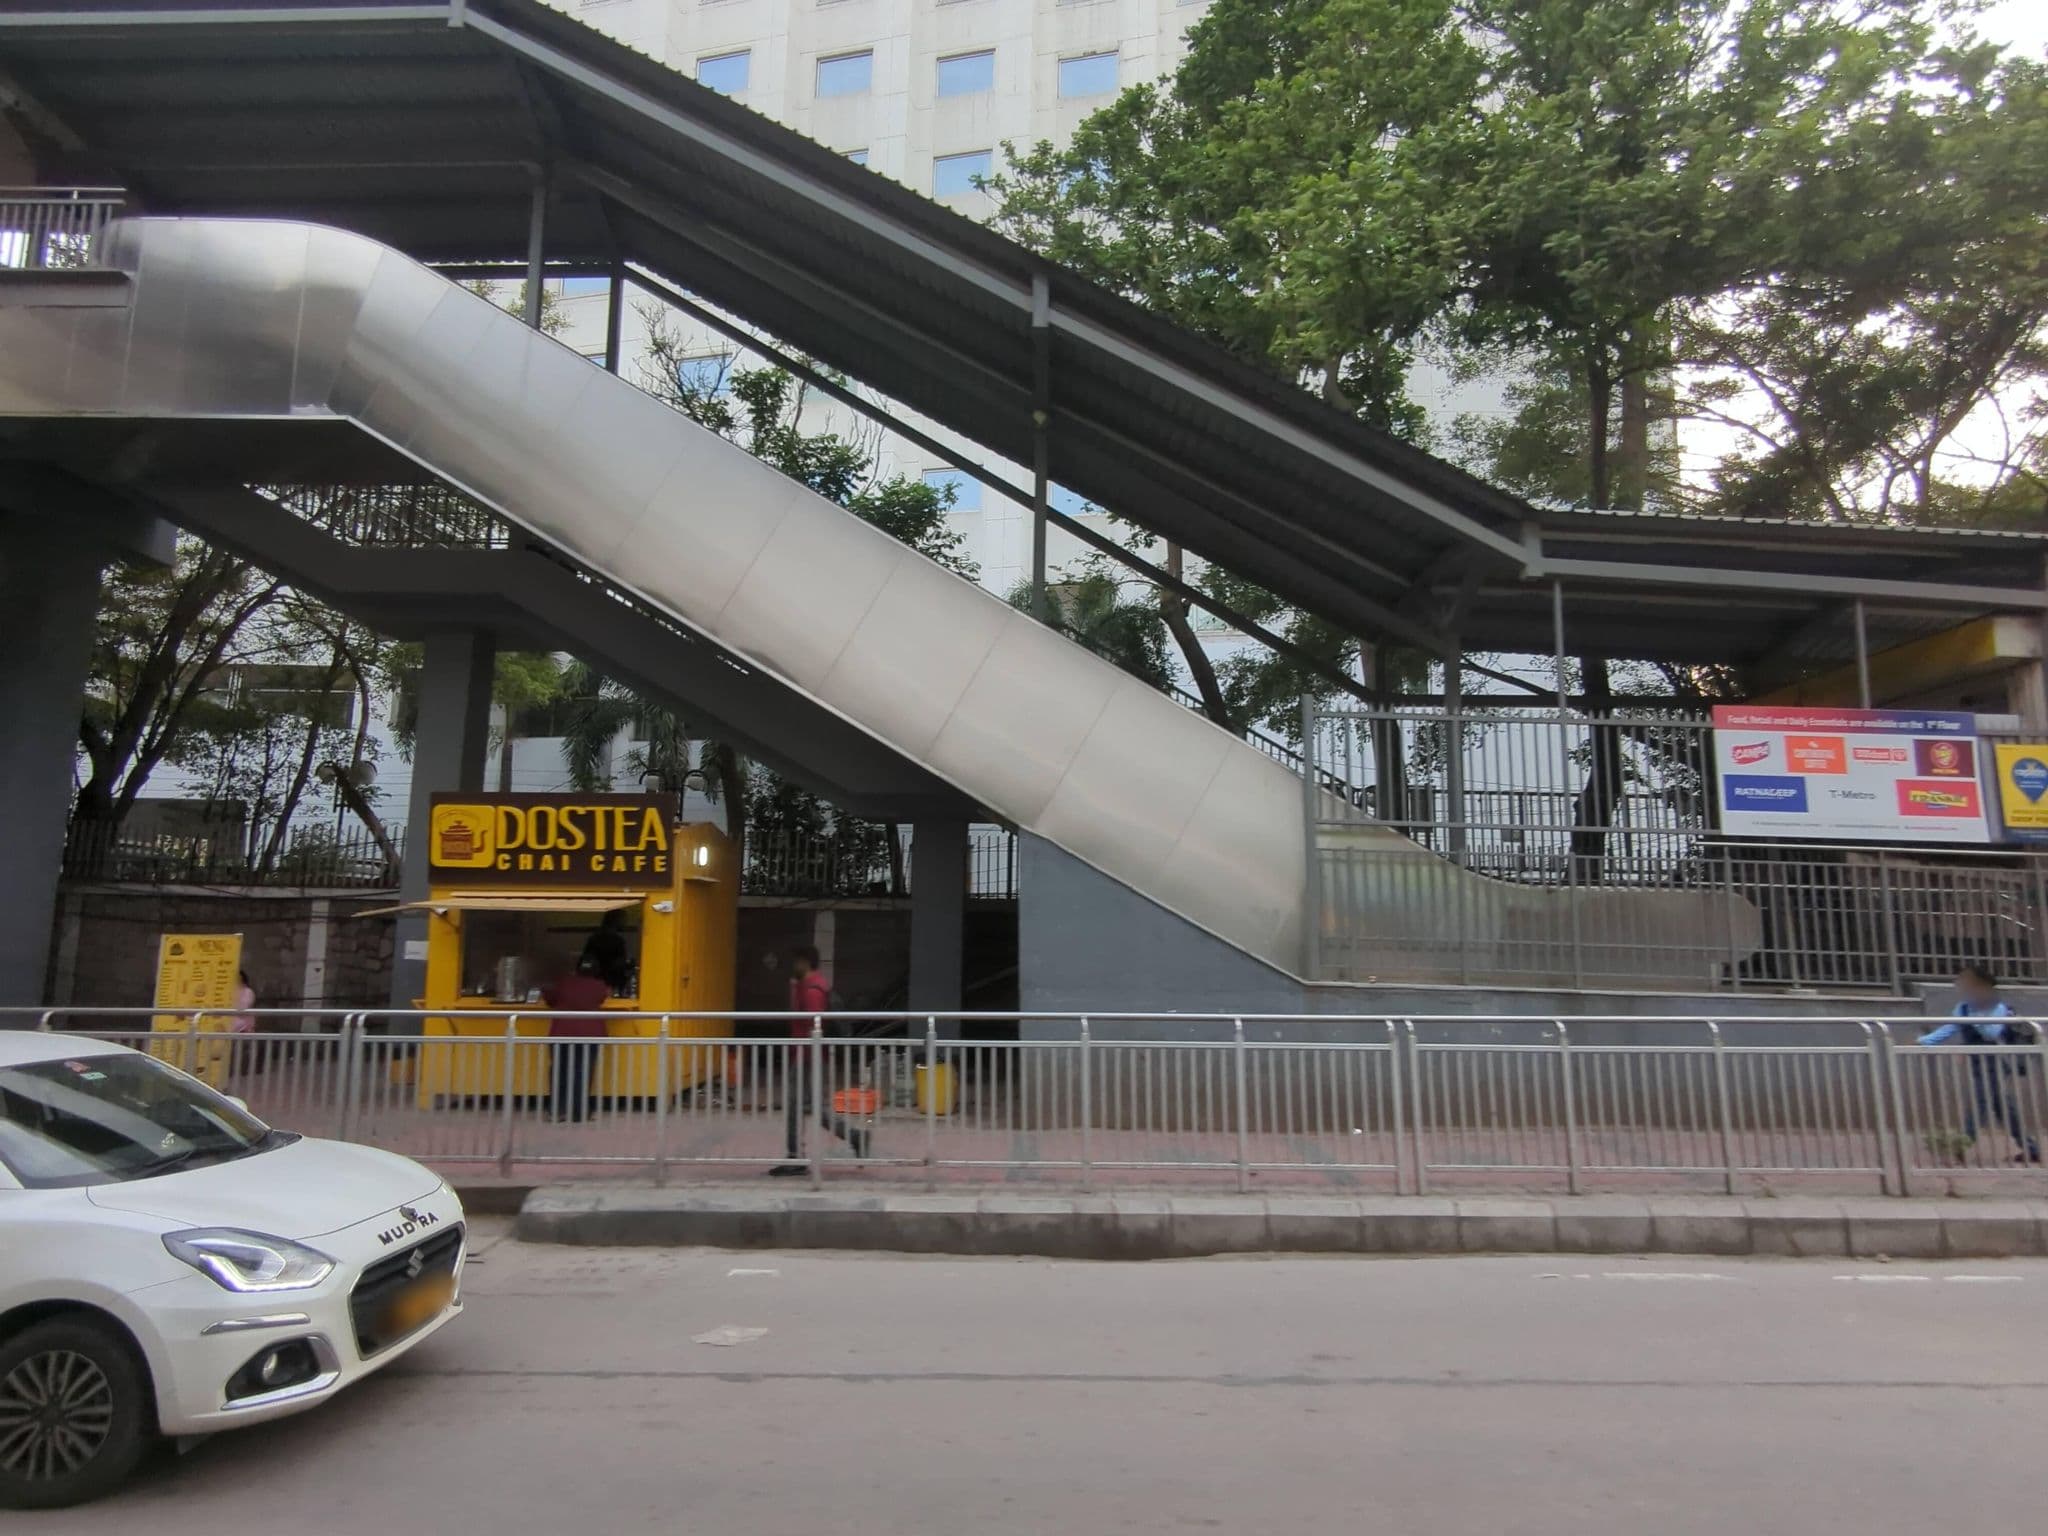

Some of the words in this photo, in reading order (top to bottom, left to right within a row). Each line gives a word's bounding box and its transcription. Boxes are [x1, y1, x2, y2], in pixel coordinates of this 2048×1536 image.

[1828, 788, 1878, 800] T-Metro
[496, 805, 668, 852] DOSTEA
[496, 853, 570, 872] CHAI
[591, 854, 667, 873] CAFE
